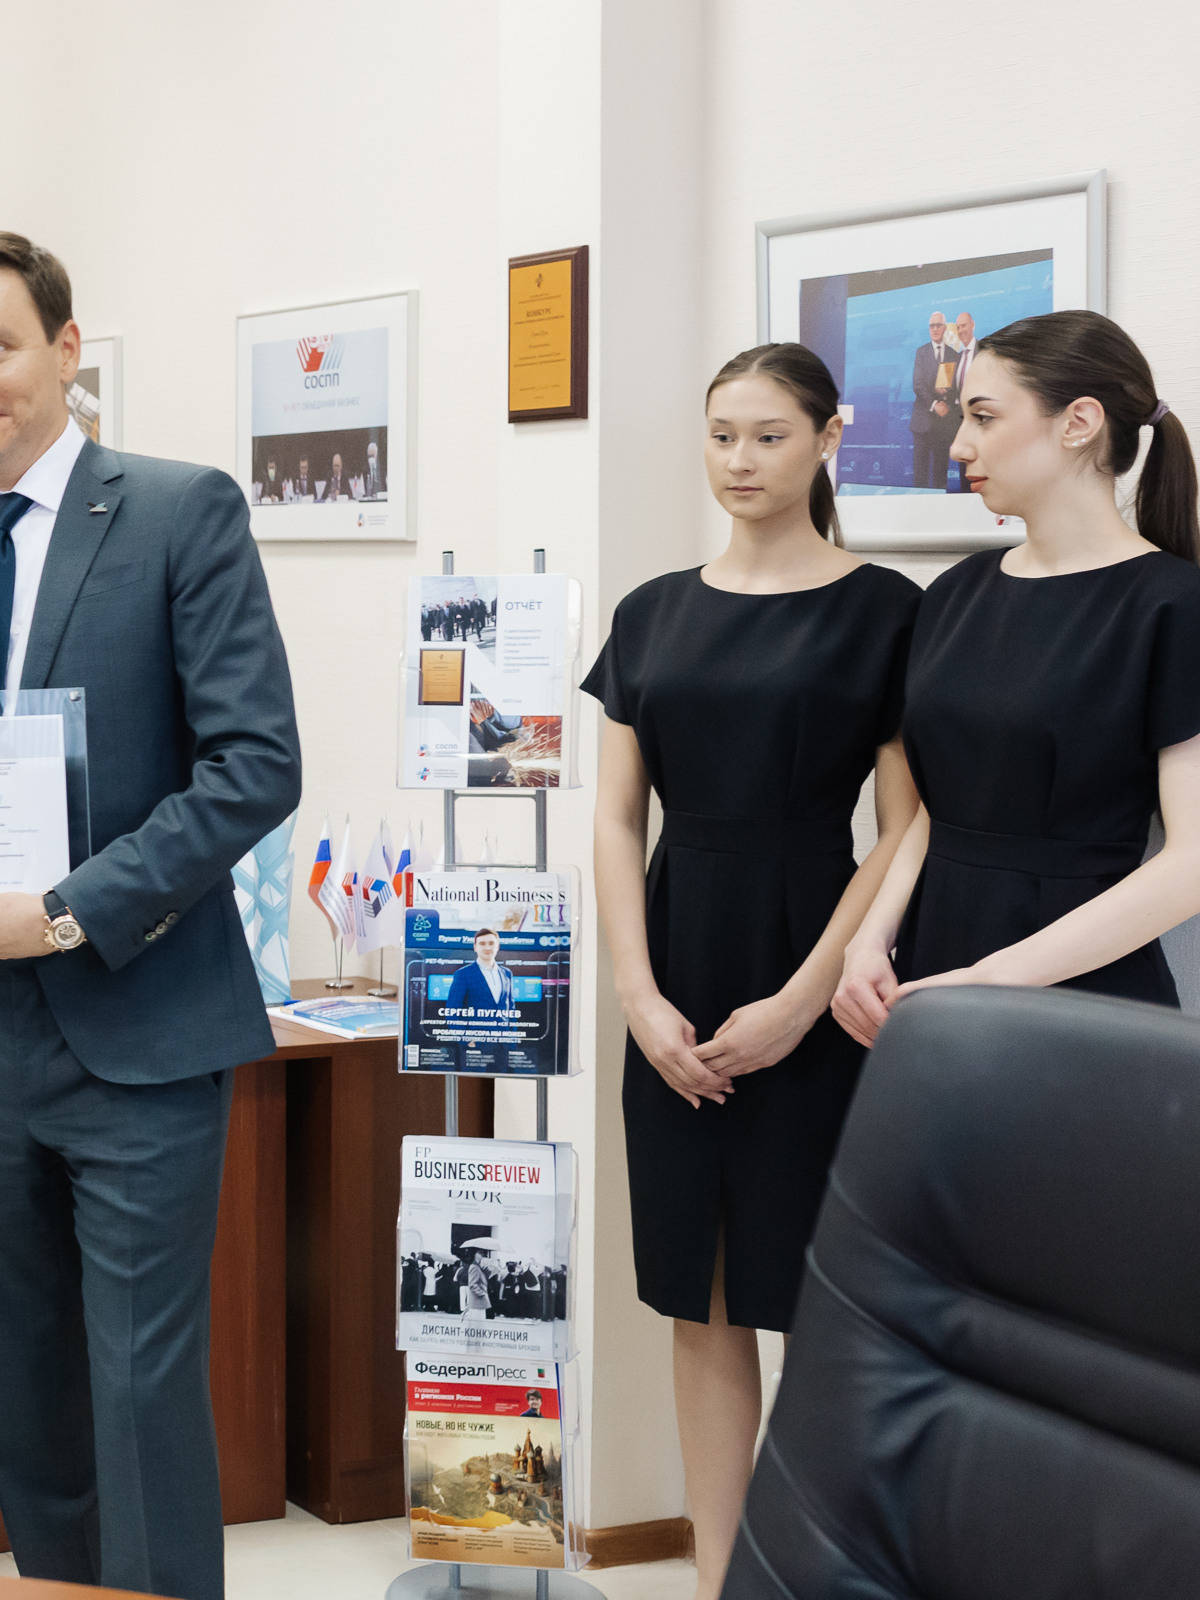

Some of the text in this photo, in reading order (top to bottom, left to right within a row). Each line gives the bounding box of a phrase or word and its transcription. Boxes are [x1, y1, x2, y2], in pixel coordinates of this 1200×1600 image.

[304, 373, 340, 389] СОСПП
[505, 600, 543, 611] ОТЧЁТ
[416, 878, 479, 902] National
[485, 879, 553, 903] Business
[438, 1007, 522, 1018] СЕРГЕЙ ПУГАЧЕВ
[415, 1146, 431, 1158] FP
[422, 1324, 529, 1342] ДИСТАНТ-КОНКУРЕНЦИЯ
[415, 1361, 527, 1381] ФедералПресс
[416, 1420, 495, 1433] НОВЫЕ, НО НЕ ЧУЖИЕ
